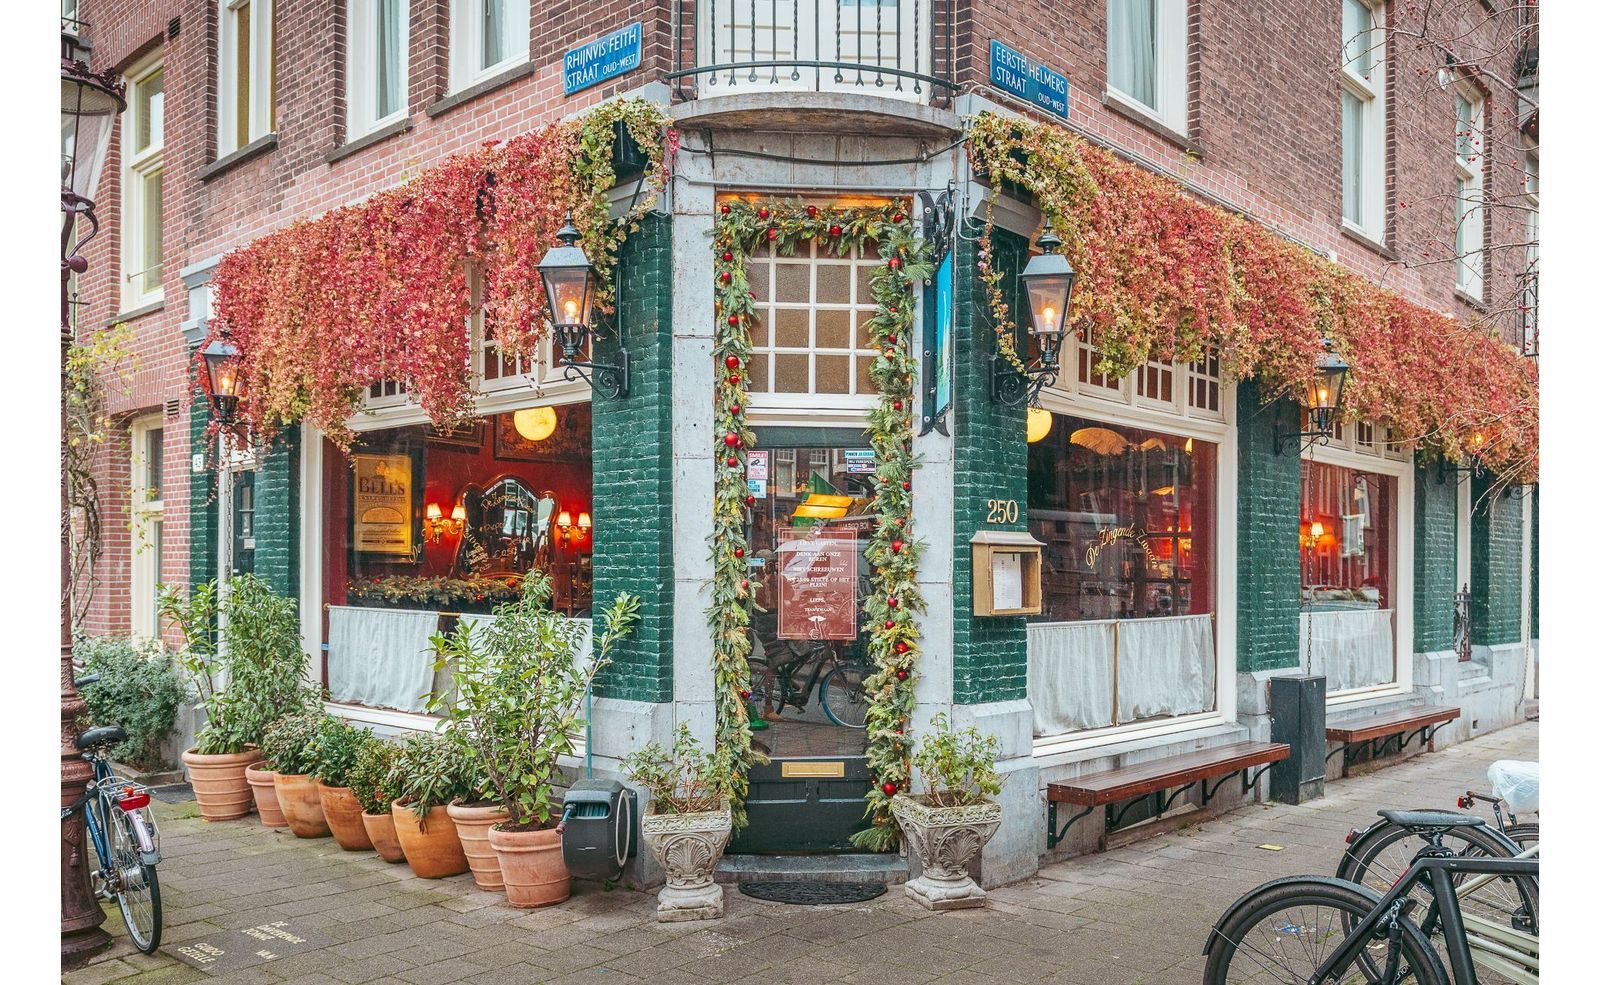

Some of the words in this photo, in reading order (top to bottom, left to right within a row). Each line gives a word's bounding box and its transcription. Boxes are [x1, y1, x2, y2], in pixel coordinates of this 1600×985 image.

[567, 41, 606, 70] RHIJNVIS
[609, 28, 637, 53] FEITH
[567, 63, 600, 89] STRAAT
[602, 53, 636, 75] OUD-WEST
[996, 46, 1027, 75] EERSTE
[1028, 63, 1065, 95] HELMERS
[996, 66, 1027, 94] STRAAT
[1038, 92, 1065, 113] OUD-WEST
[987, 499, 1019, 524] 250
[1085, 543, 1100, 569] De
[1098, 522, 1136, 549] Zingende
[1136, 528, 1158, 569] Zwaan
[177, 946, 216, 964] GEZELLE
[194, 942, 225, 956] GUIDO
